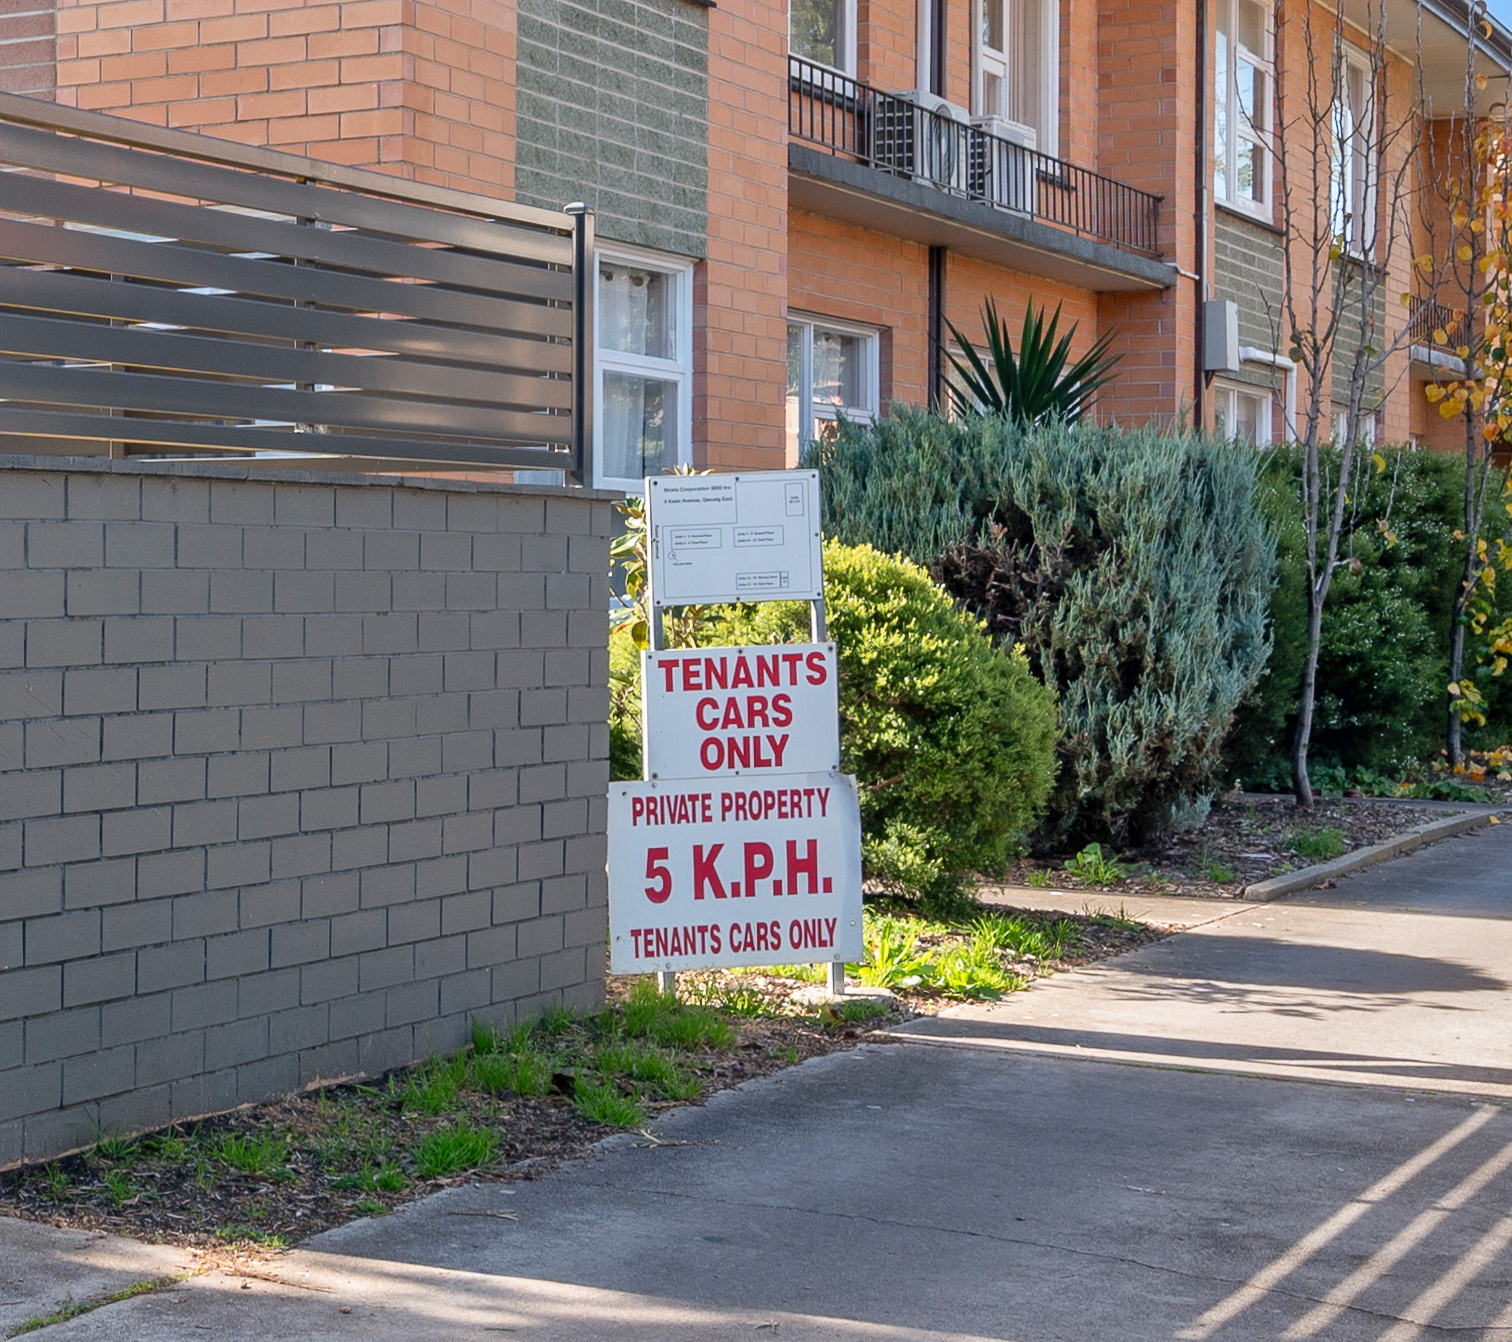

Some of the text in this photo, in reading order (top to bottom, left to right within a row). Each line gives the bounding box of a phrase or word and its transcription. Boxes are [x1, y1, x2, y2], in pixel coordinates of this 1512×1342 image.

[658, 652, 827, 692] TENANTS
[696, 693, 793, 731] CARS
[700, 734, 789, 770] ONLY
[632, 787, 830, 826] PRIVATE PROPERTY
[644, 838, 833, 904] 5 K.P.H.
[630, 917, 837, 959] TENANTS CARS ONLY
